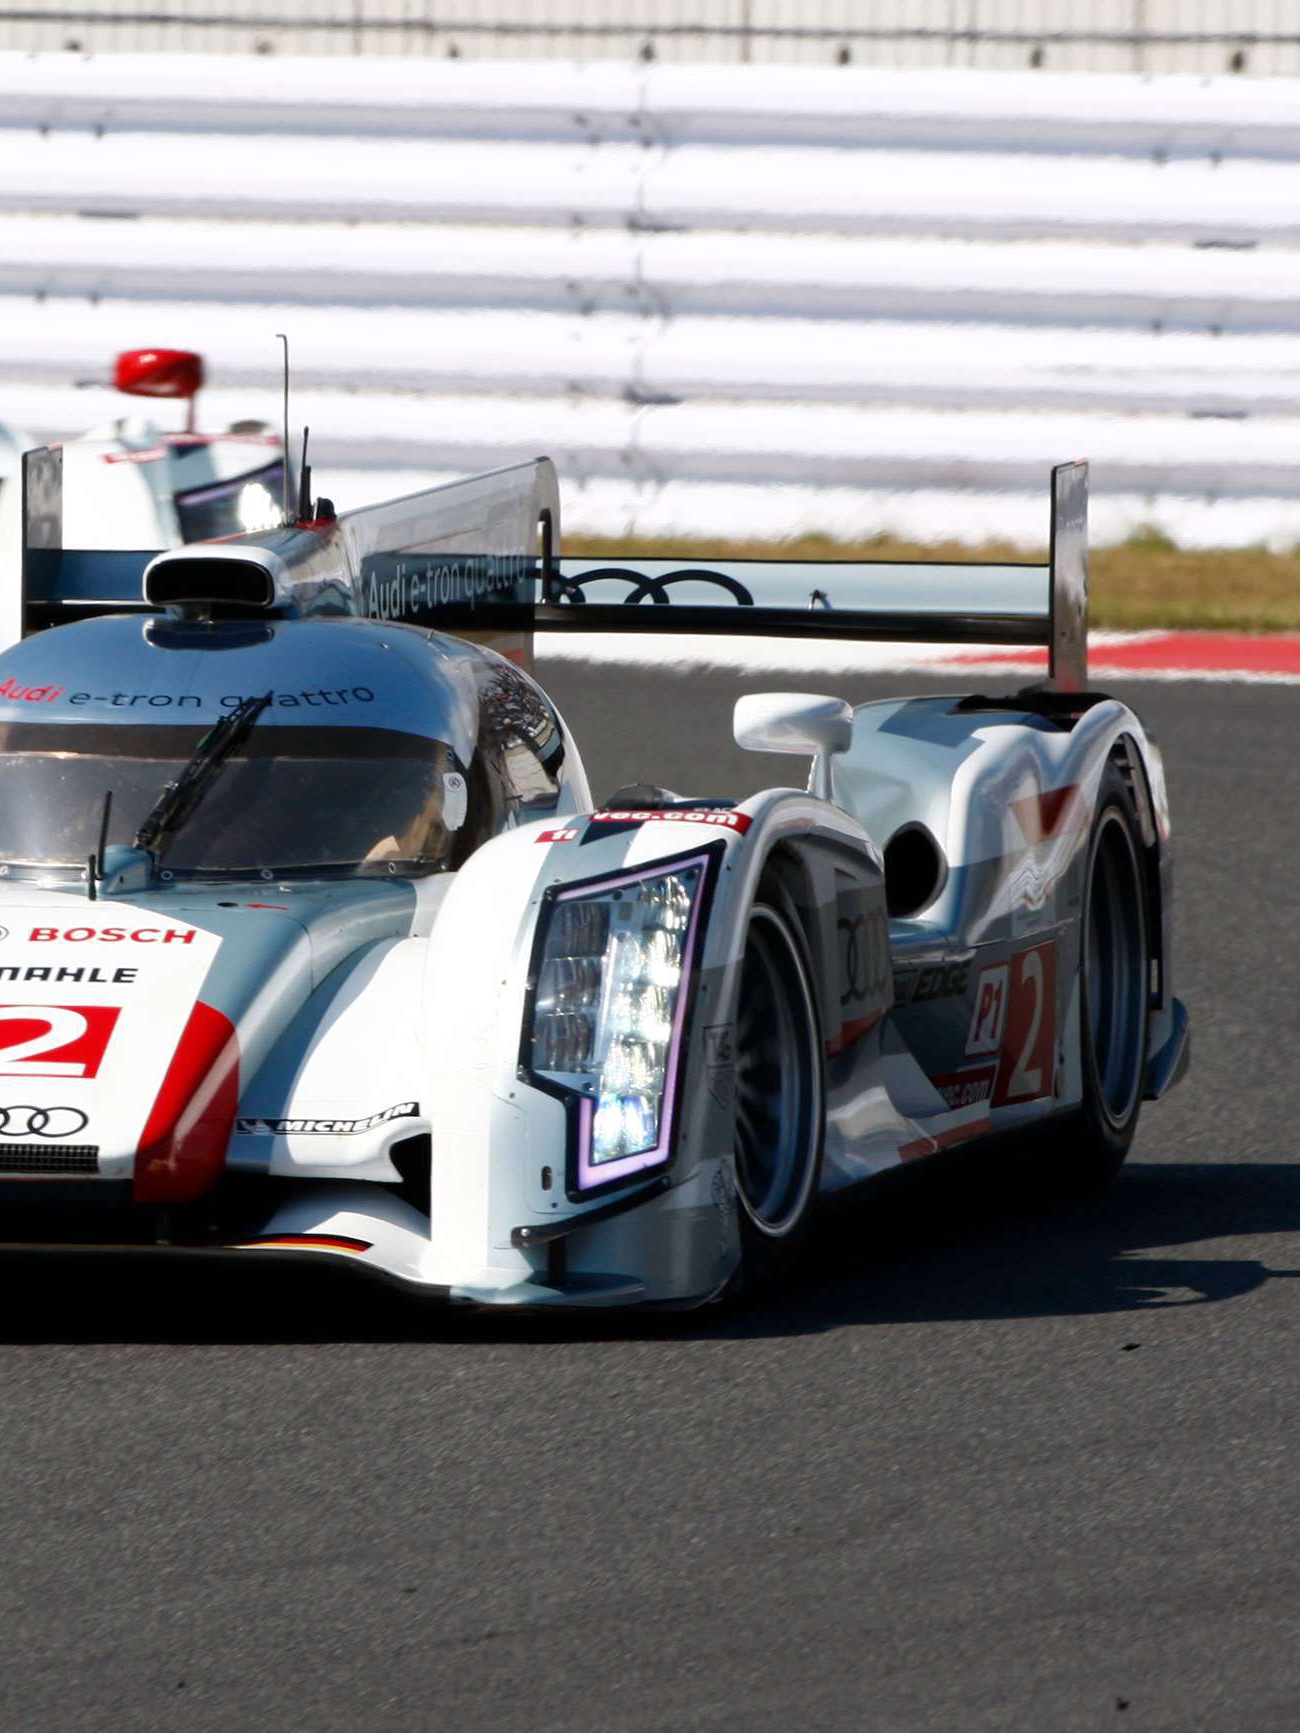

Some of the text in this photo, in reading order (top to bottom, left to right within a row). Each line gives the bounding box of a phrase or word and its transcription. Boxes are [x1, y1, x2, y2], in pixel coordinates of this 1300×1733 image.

[368, 545, 527, 620] Audi e-tron quattro
[68, 690, 202, 708] e-tron
[219, 686, 375, 712] qattro
[27, 927, 197, 945] BOSCH
[973, 982, 1004, 1043] P1
[1006, 950, 1045, 1098] 2
[275, 1102, 416, 1132] MICHELIN
